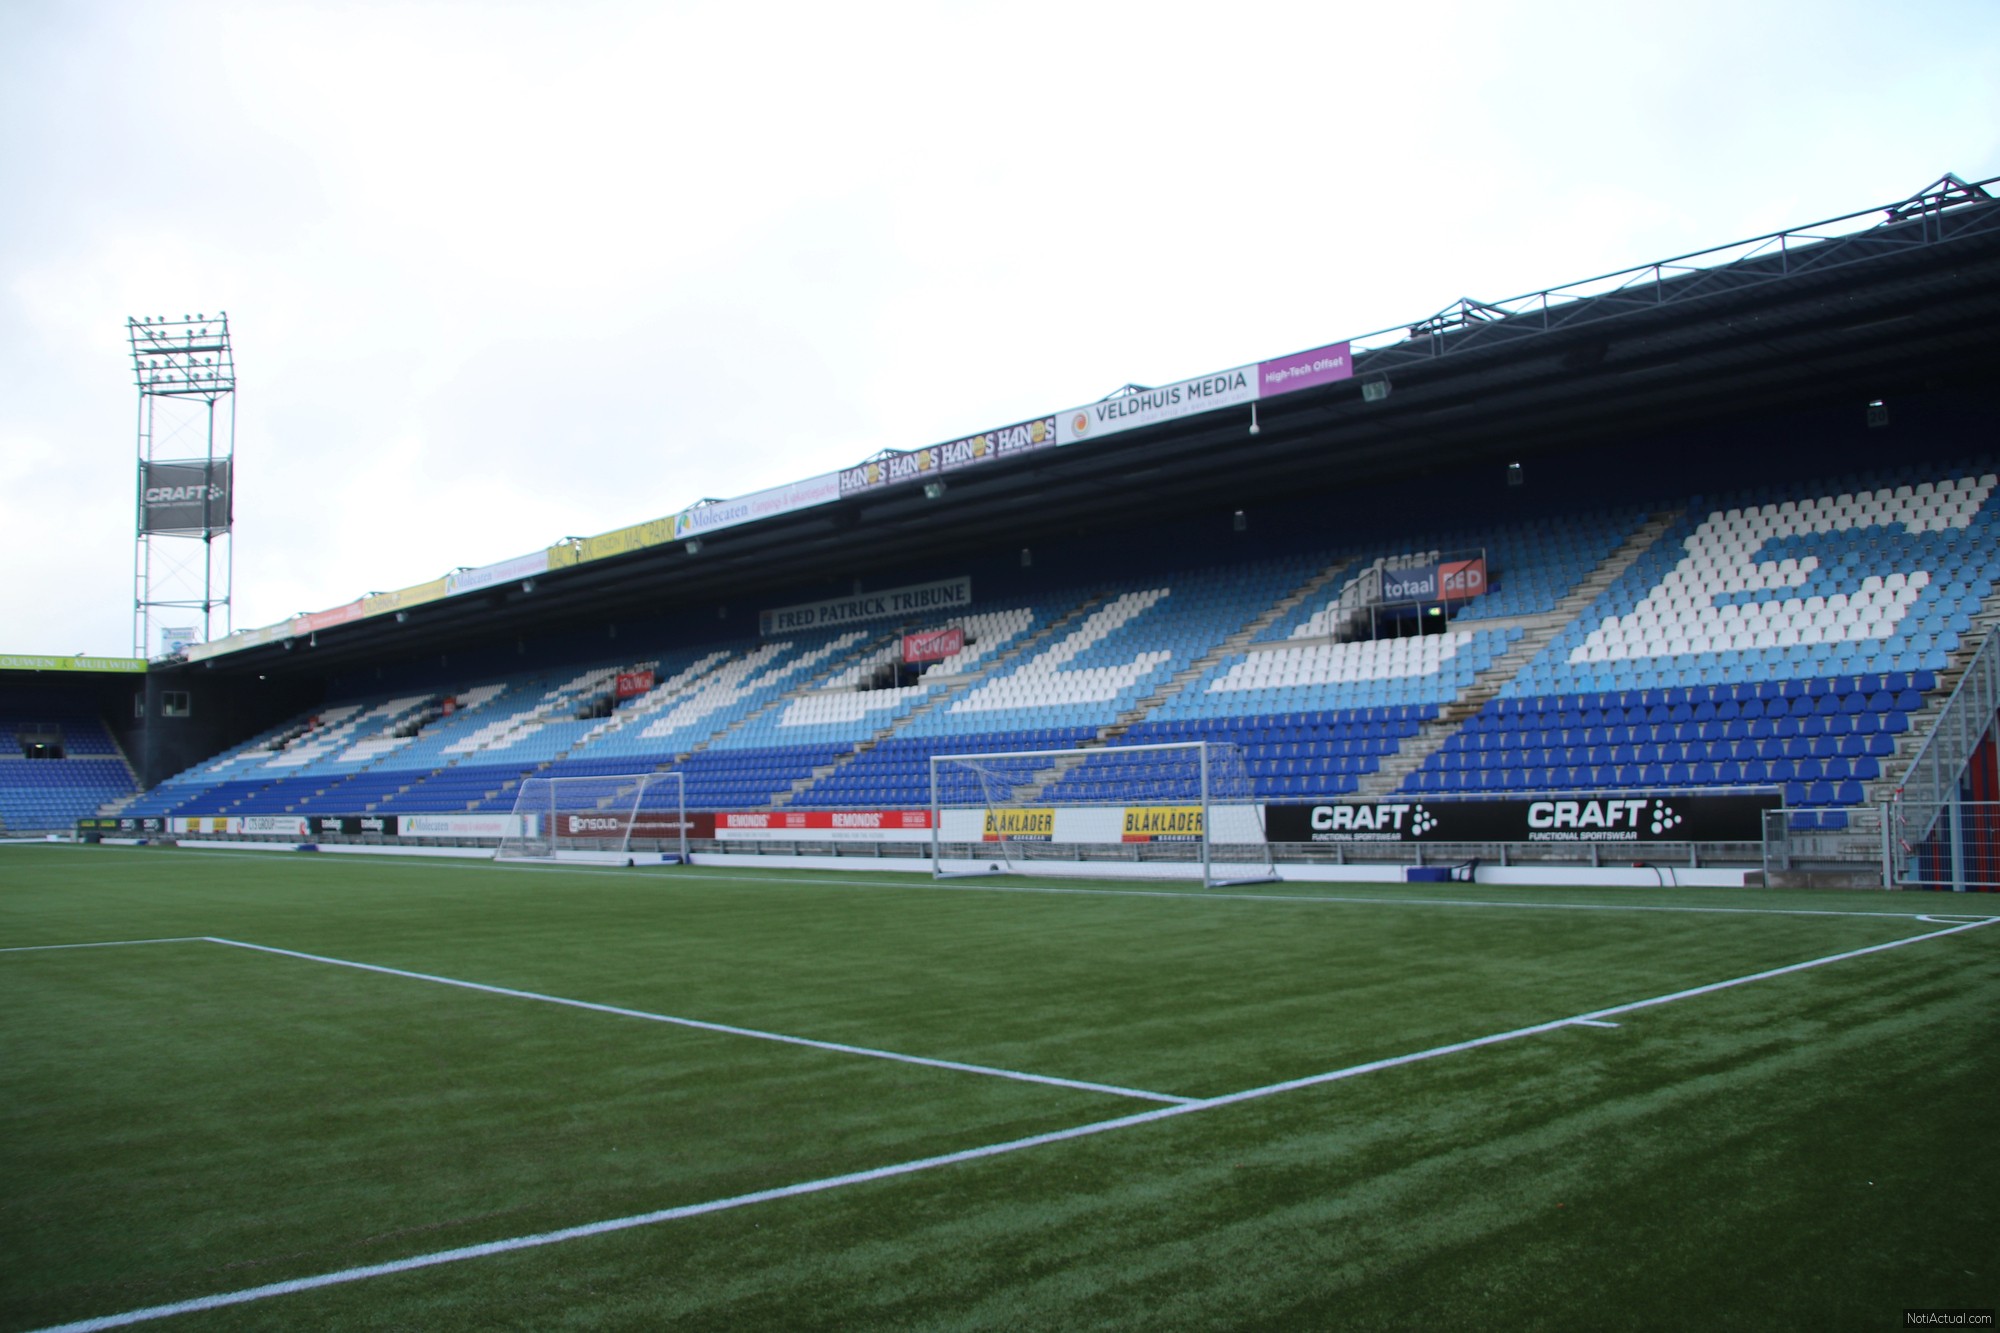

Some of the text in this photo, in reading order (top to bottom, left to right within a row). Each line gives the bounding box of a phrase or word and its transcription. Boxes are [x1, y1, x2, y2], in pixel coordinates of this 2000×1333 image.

[1265, 356, 1343, 384] High-Tech Offset
[1096, 371, 1247, 422] VELDHUIS MEDIA
[146, 485, 208, 502] CRAFT
[692, 504, 748, 528] Molecaten
[1384, 569, 1483, 597] totaal BED
[778, 583, 967, 629] FRED PATRICK TRIBUNE
[1311, 804, 1410, 831] CRAFT
[1527, 800, 1648, 829] CRAFT
[1312, 832, 1402, 842] FUNCTIONAL SPORTSWEAR
[1528, 831, 1638, 841] FUNCTIONAL SPORTSWEAR
